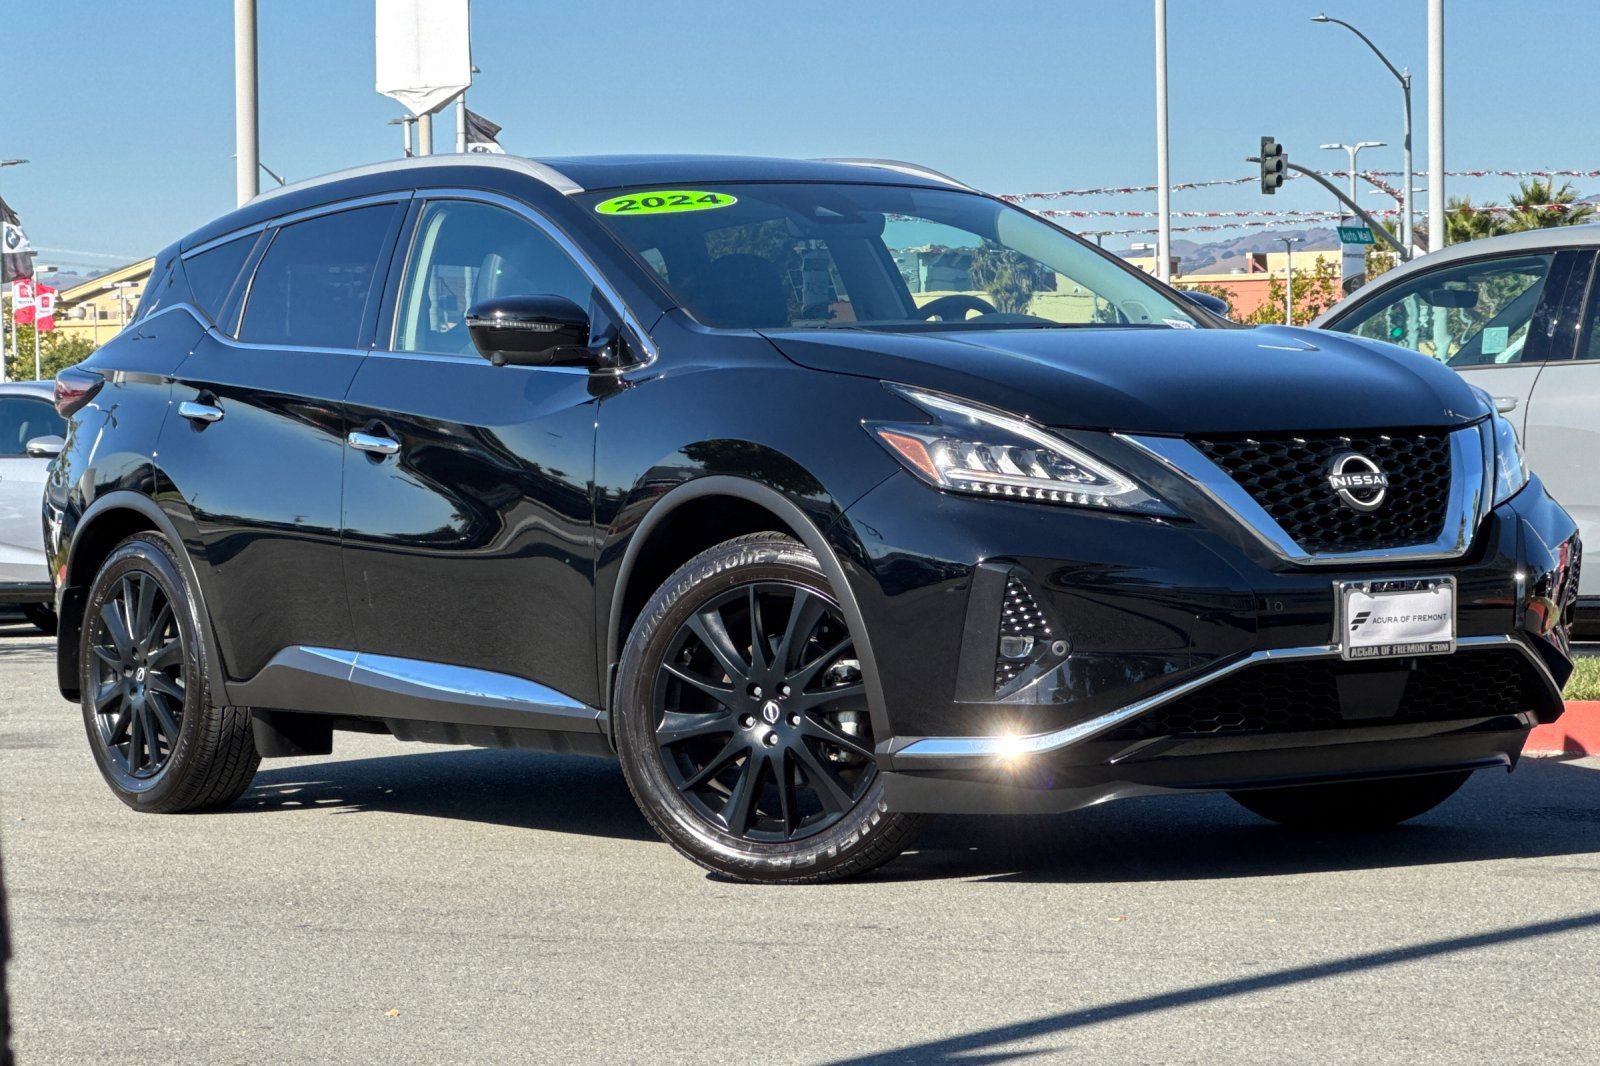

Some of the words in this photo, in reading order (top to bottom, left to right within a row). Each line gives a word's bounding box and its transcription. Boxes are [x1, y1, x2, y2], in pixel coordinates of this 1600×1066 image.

[614, 193, 721, 212] 2024
[1332, 475, 1388, 487] NISSAN
[1372, 616, 1399, 625] ACURA
[1400, 615, 1411, 623] OF
[1412, 613, 1447, 622] FREMONT
[1351, 646, 1379, 658] ACURA
[1381, 645, 1392, 656] OF
